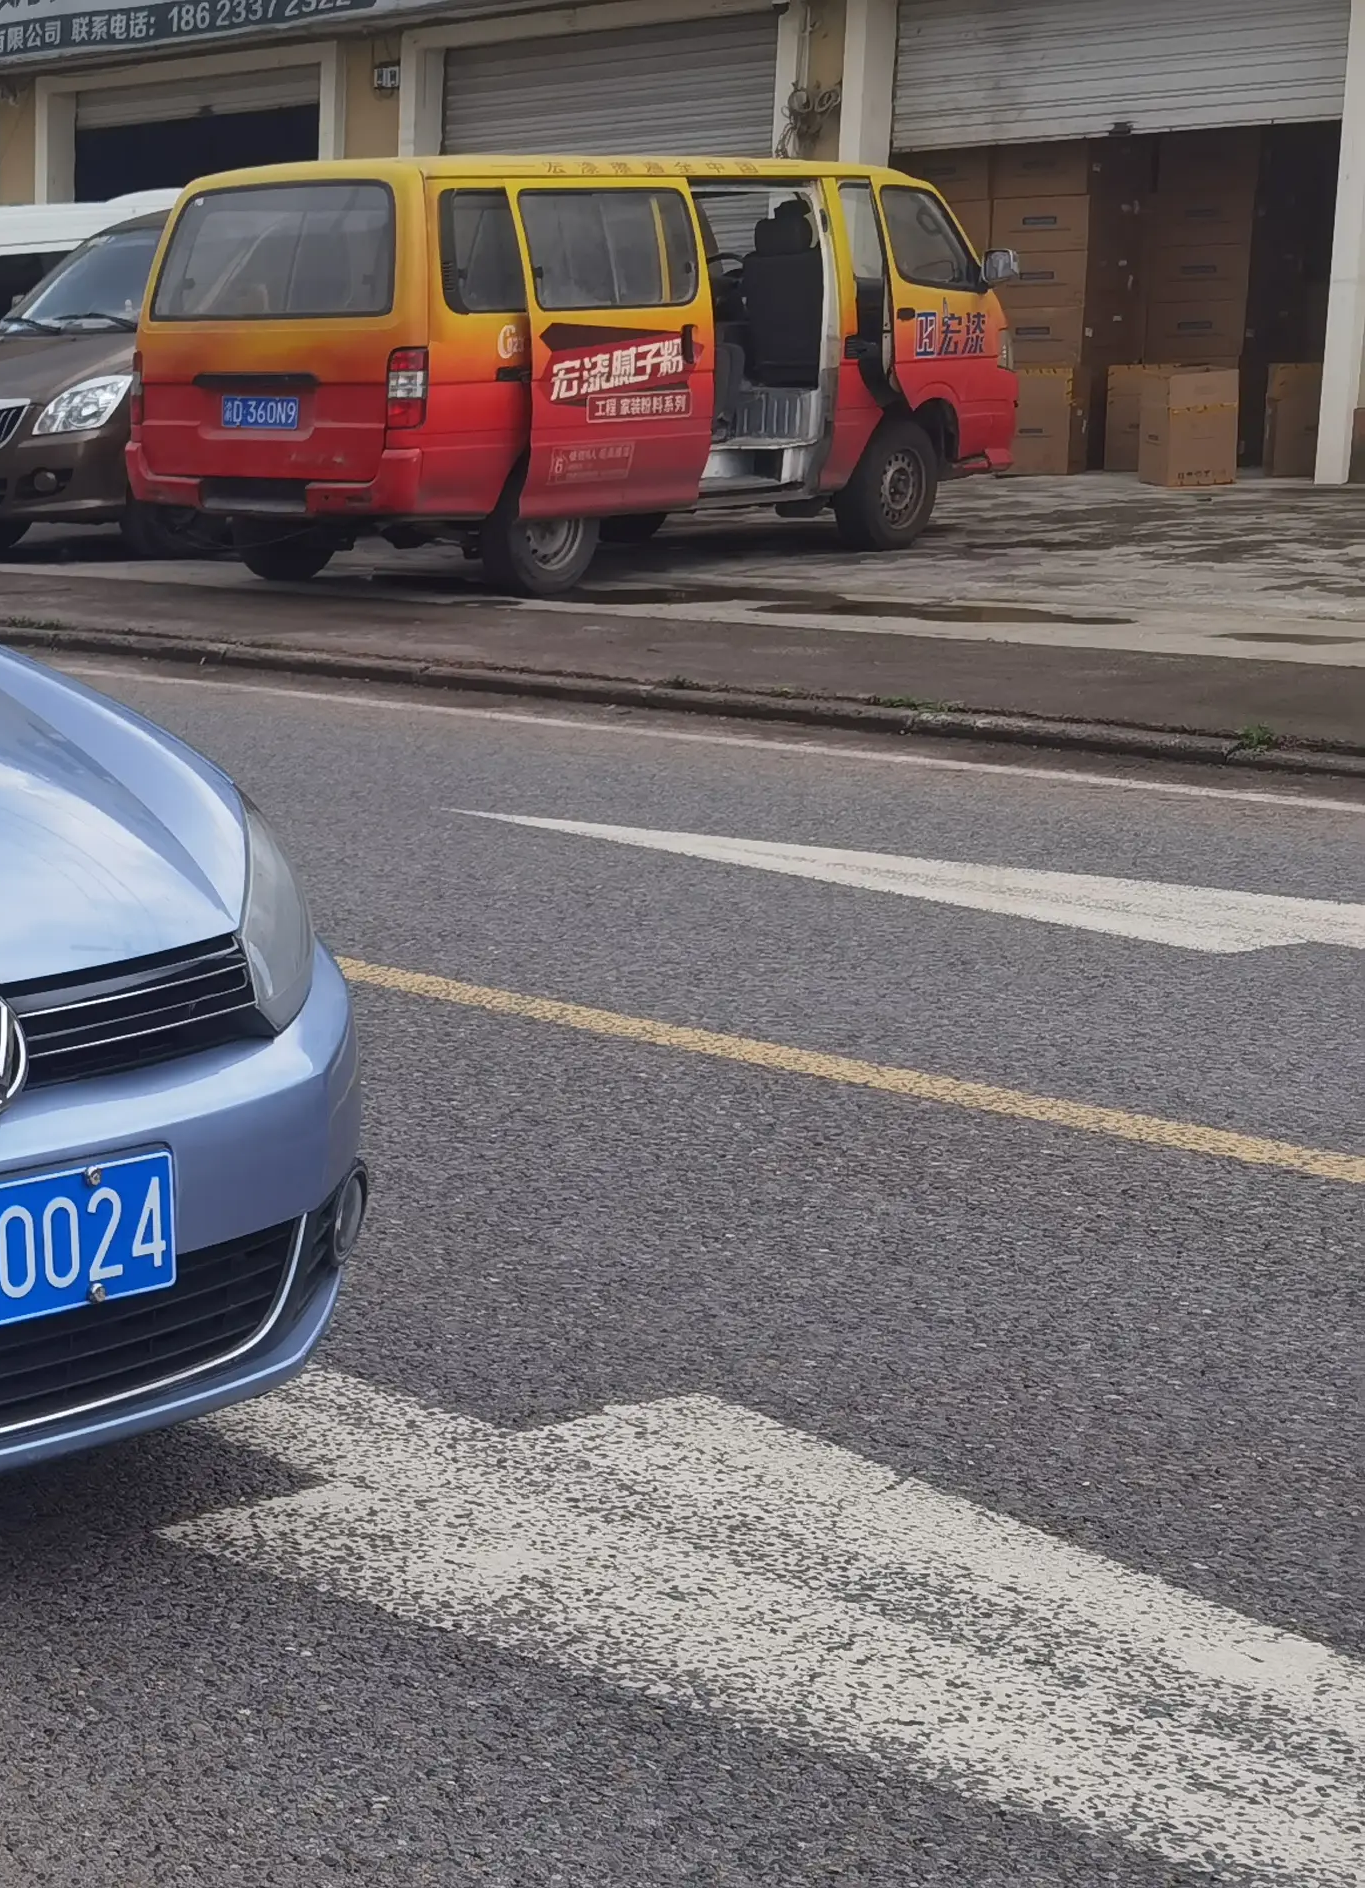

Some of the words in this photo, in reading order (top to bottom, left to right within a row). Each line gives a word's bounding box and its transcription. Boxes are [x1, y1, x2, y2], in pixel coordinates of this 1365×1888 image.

[168, 2, 210, 33] 186
[938, 311, 986, 355] 宏漆
[550, 337, 684, 401] 宏漆腻子粉
[594, 397, 617, 417] 工程
